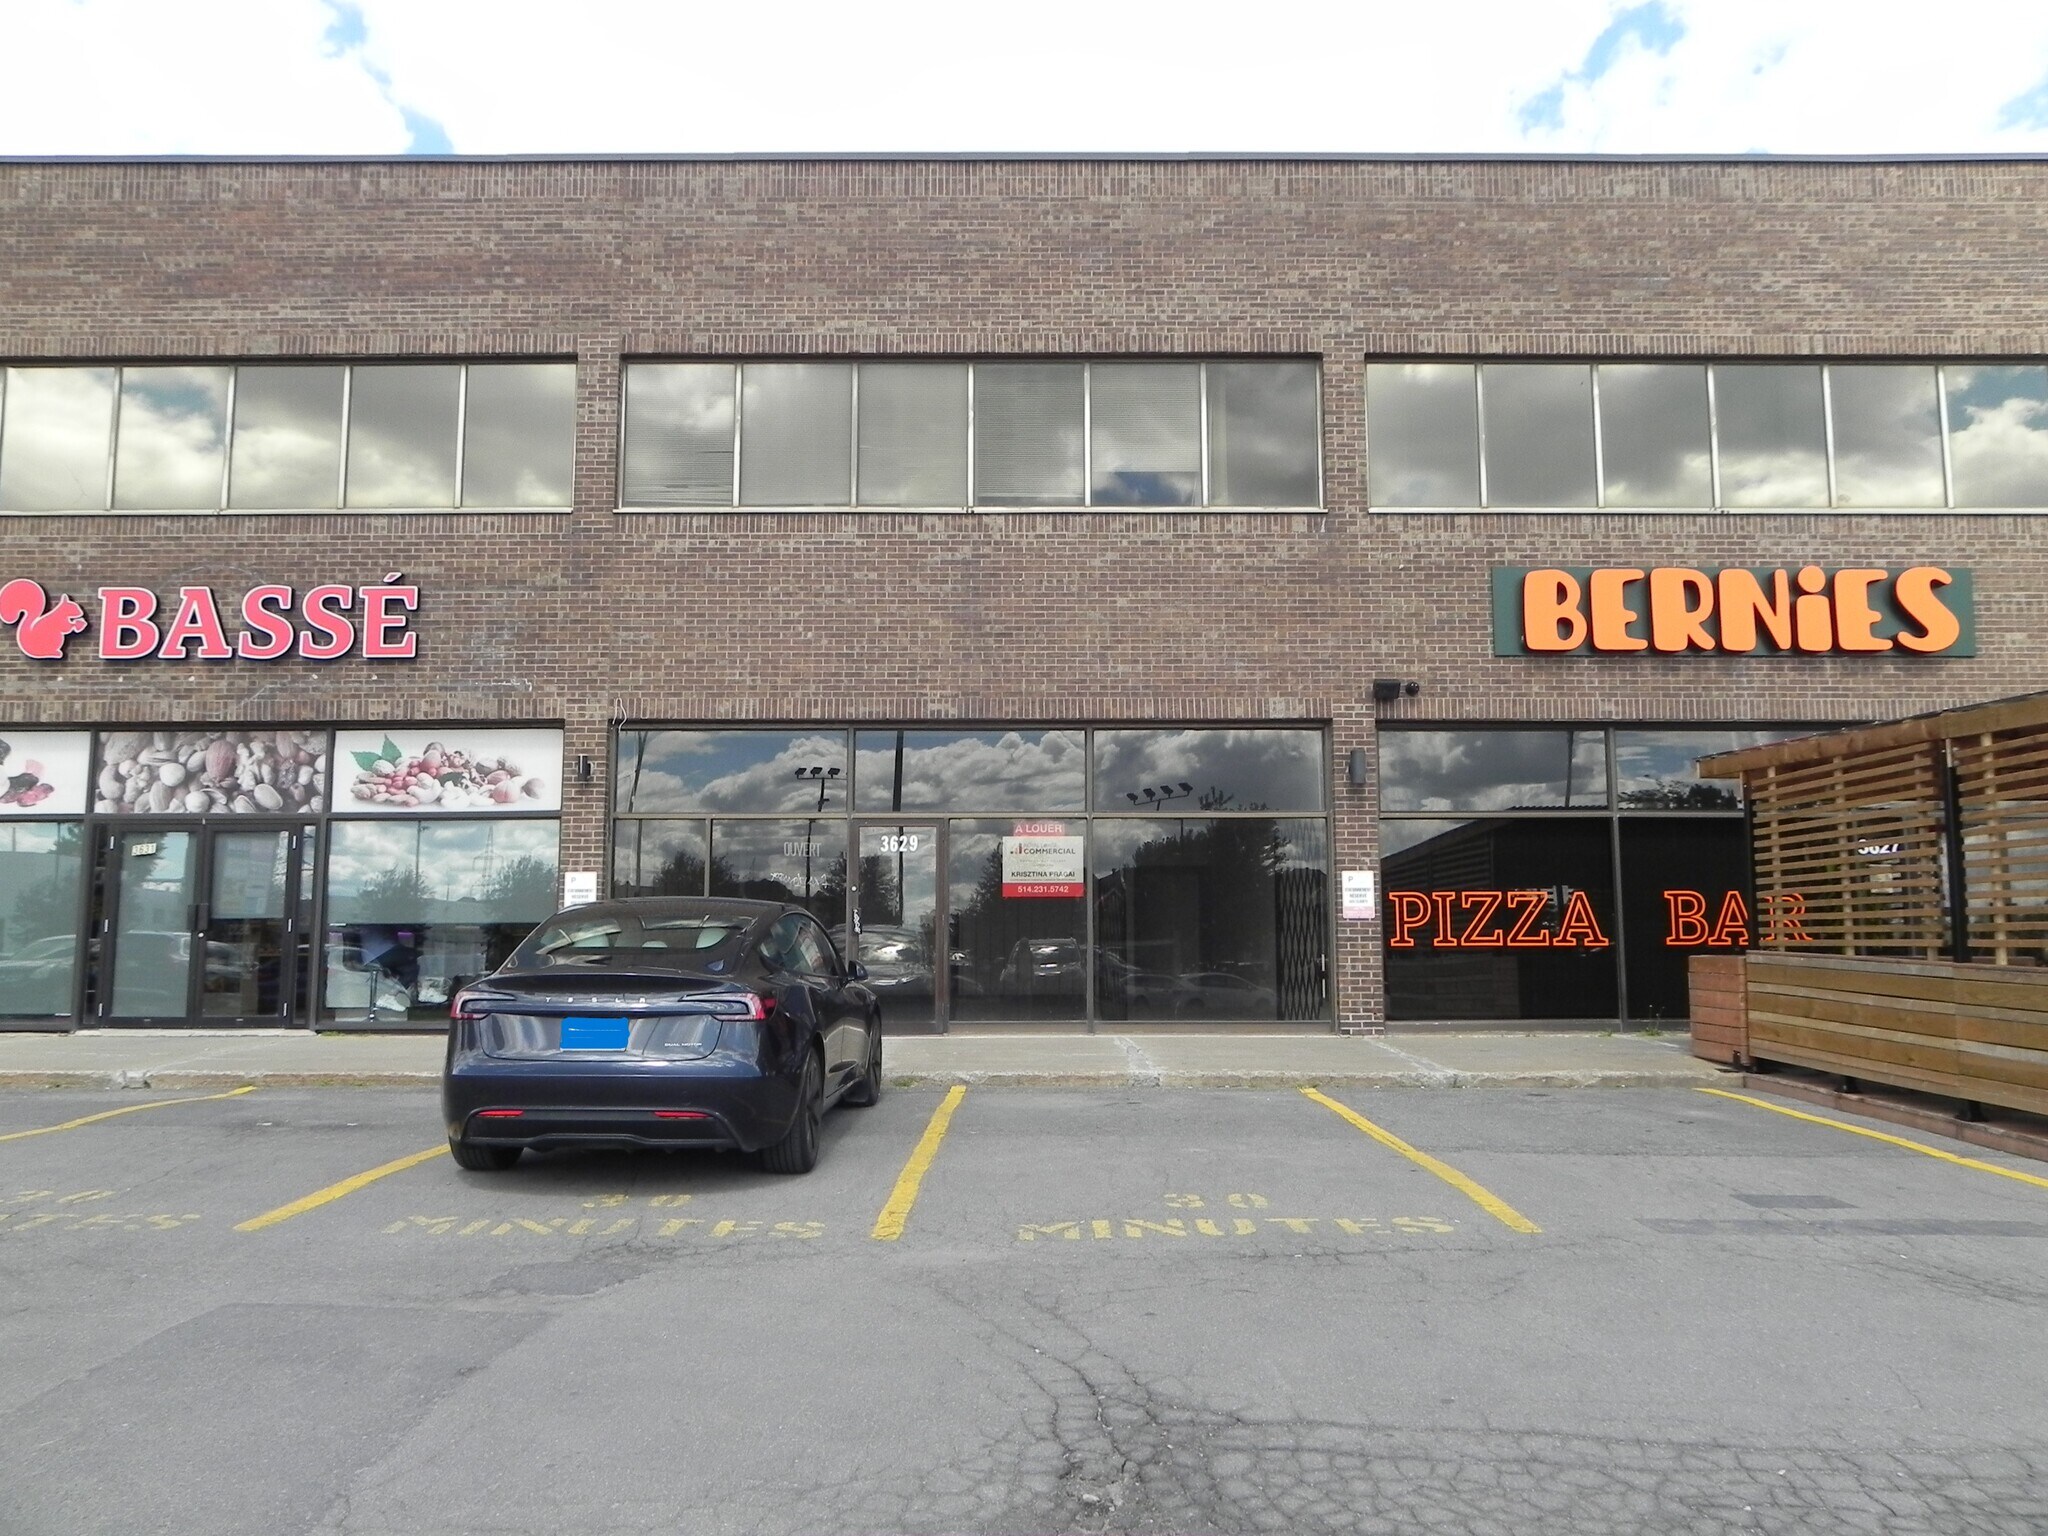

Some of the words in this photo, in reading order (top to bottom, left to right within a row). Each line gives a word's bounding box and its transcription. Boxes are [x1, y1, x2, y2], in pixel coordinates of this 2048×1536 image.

[98, 572, 419, 660] BASSÉ
[1025, 824, 1062, 833] LOUER
[133, 844, 156, 855] 3631
[783, 842, 821, 857] OUVERT
[880, 835, 918, 852] 3629
[1017, 885, 1069, 893] 514.231.5742
[1388, 890, 1610, 947] PIZZA
[1162, 1193, 1270, 1208] 30
[382, 1216, 827, 1238] MINUTES
[1017, 1215, 1456, 1240] MINUTES
